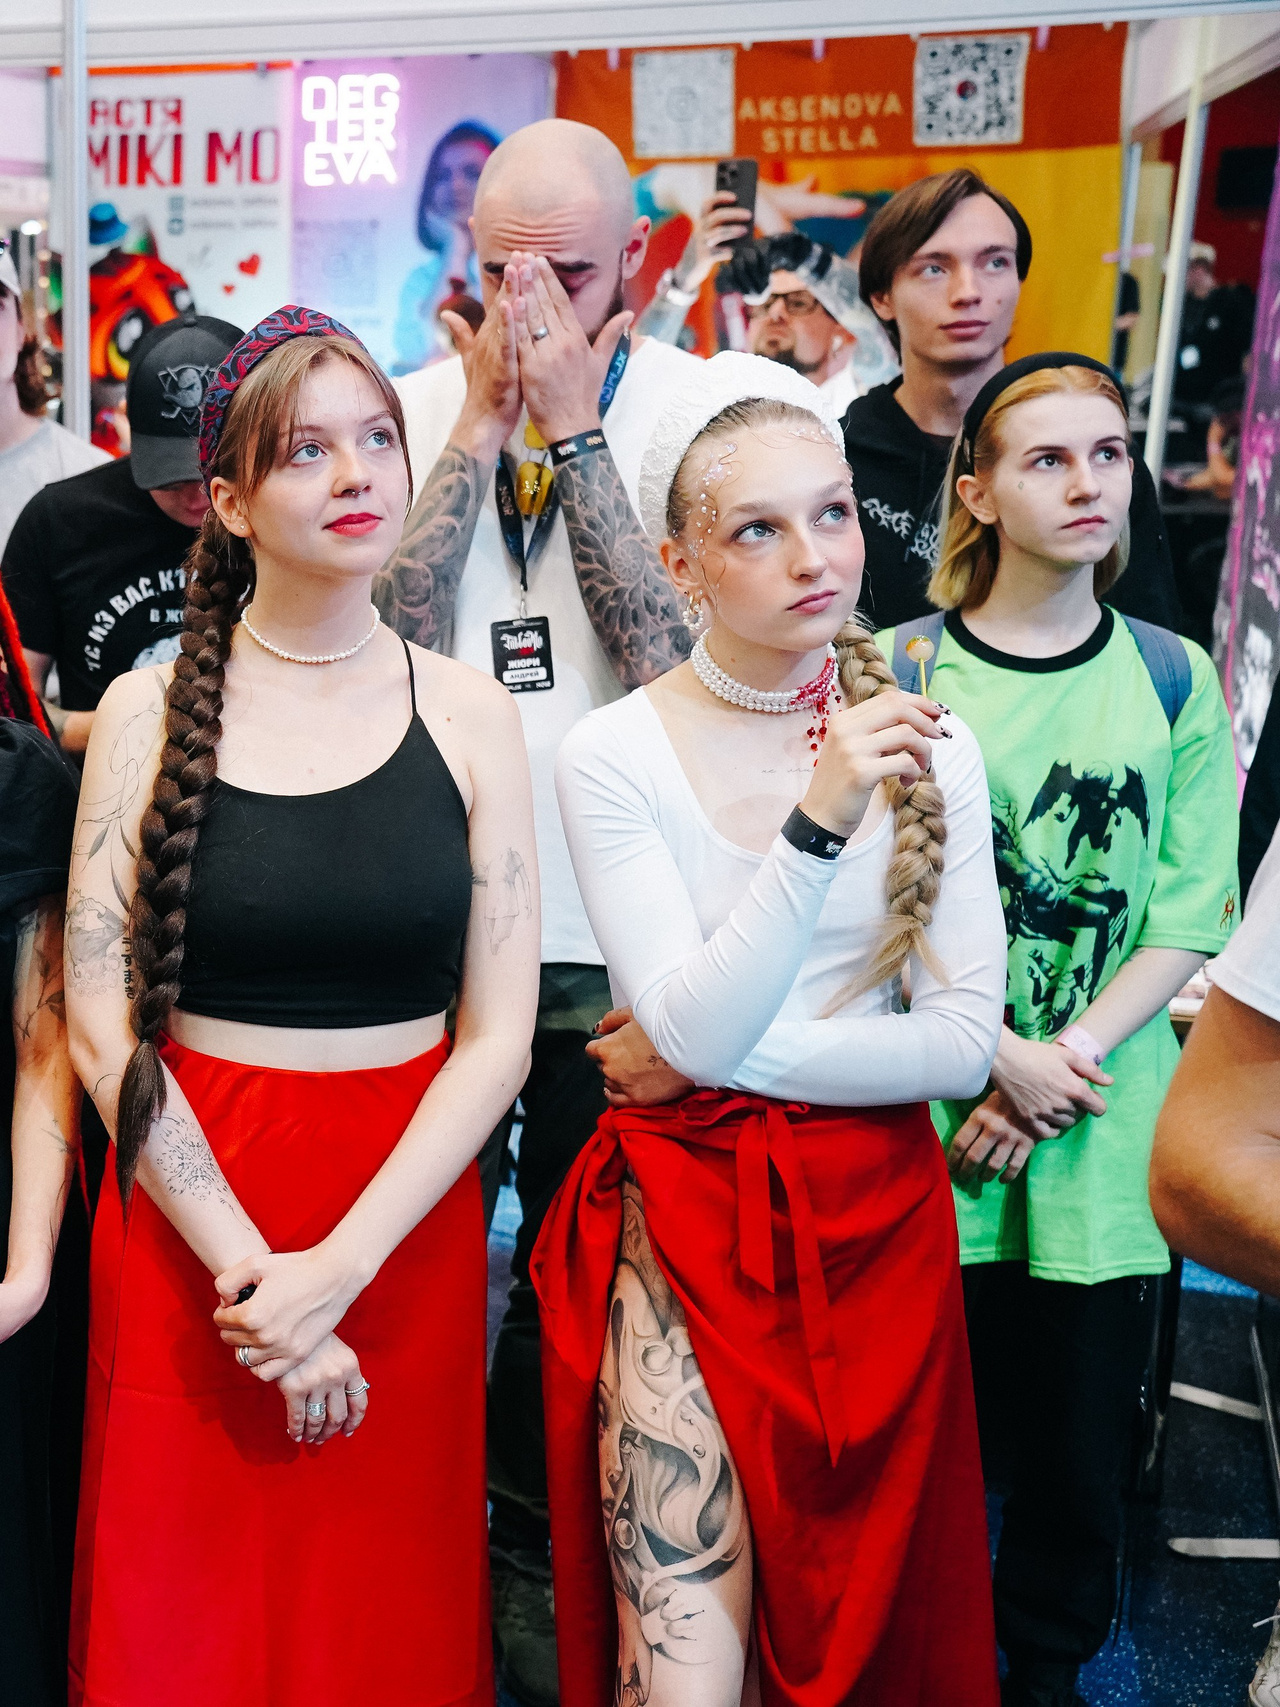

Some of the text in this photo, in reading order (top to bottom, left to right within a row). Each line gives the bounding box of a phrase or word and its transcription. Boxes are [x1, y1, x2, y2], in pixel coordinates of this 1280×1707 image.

[302, 73, 401, 121] DEG
[738, 91, 904, 121] AKSENOVA
[89, 98, 183, 128] АСТЯ
[309, 113, 397, 150] TER
[762, 126, 879, 153] STELLA
[88, 132, 183, 186] MIKI
[302, 141, 399, 187] EVA
[158, 567, 198, 592] КТ
[507, 657, 540, 669] ЖЮРИ
[509, 671, 539, 680] АНДРЕЙ
